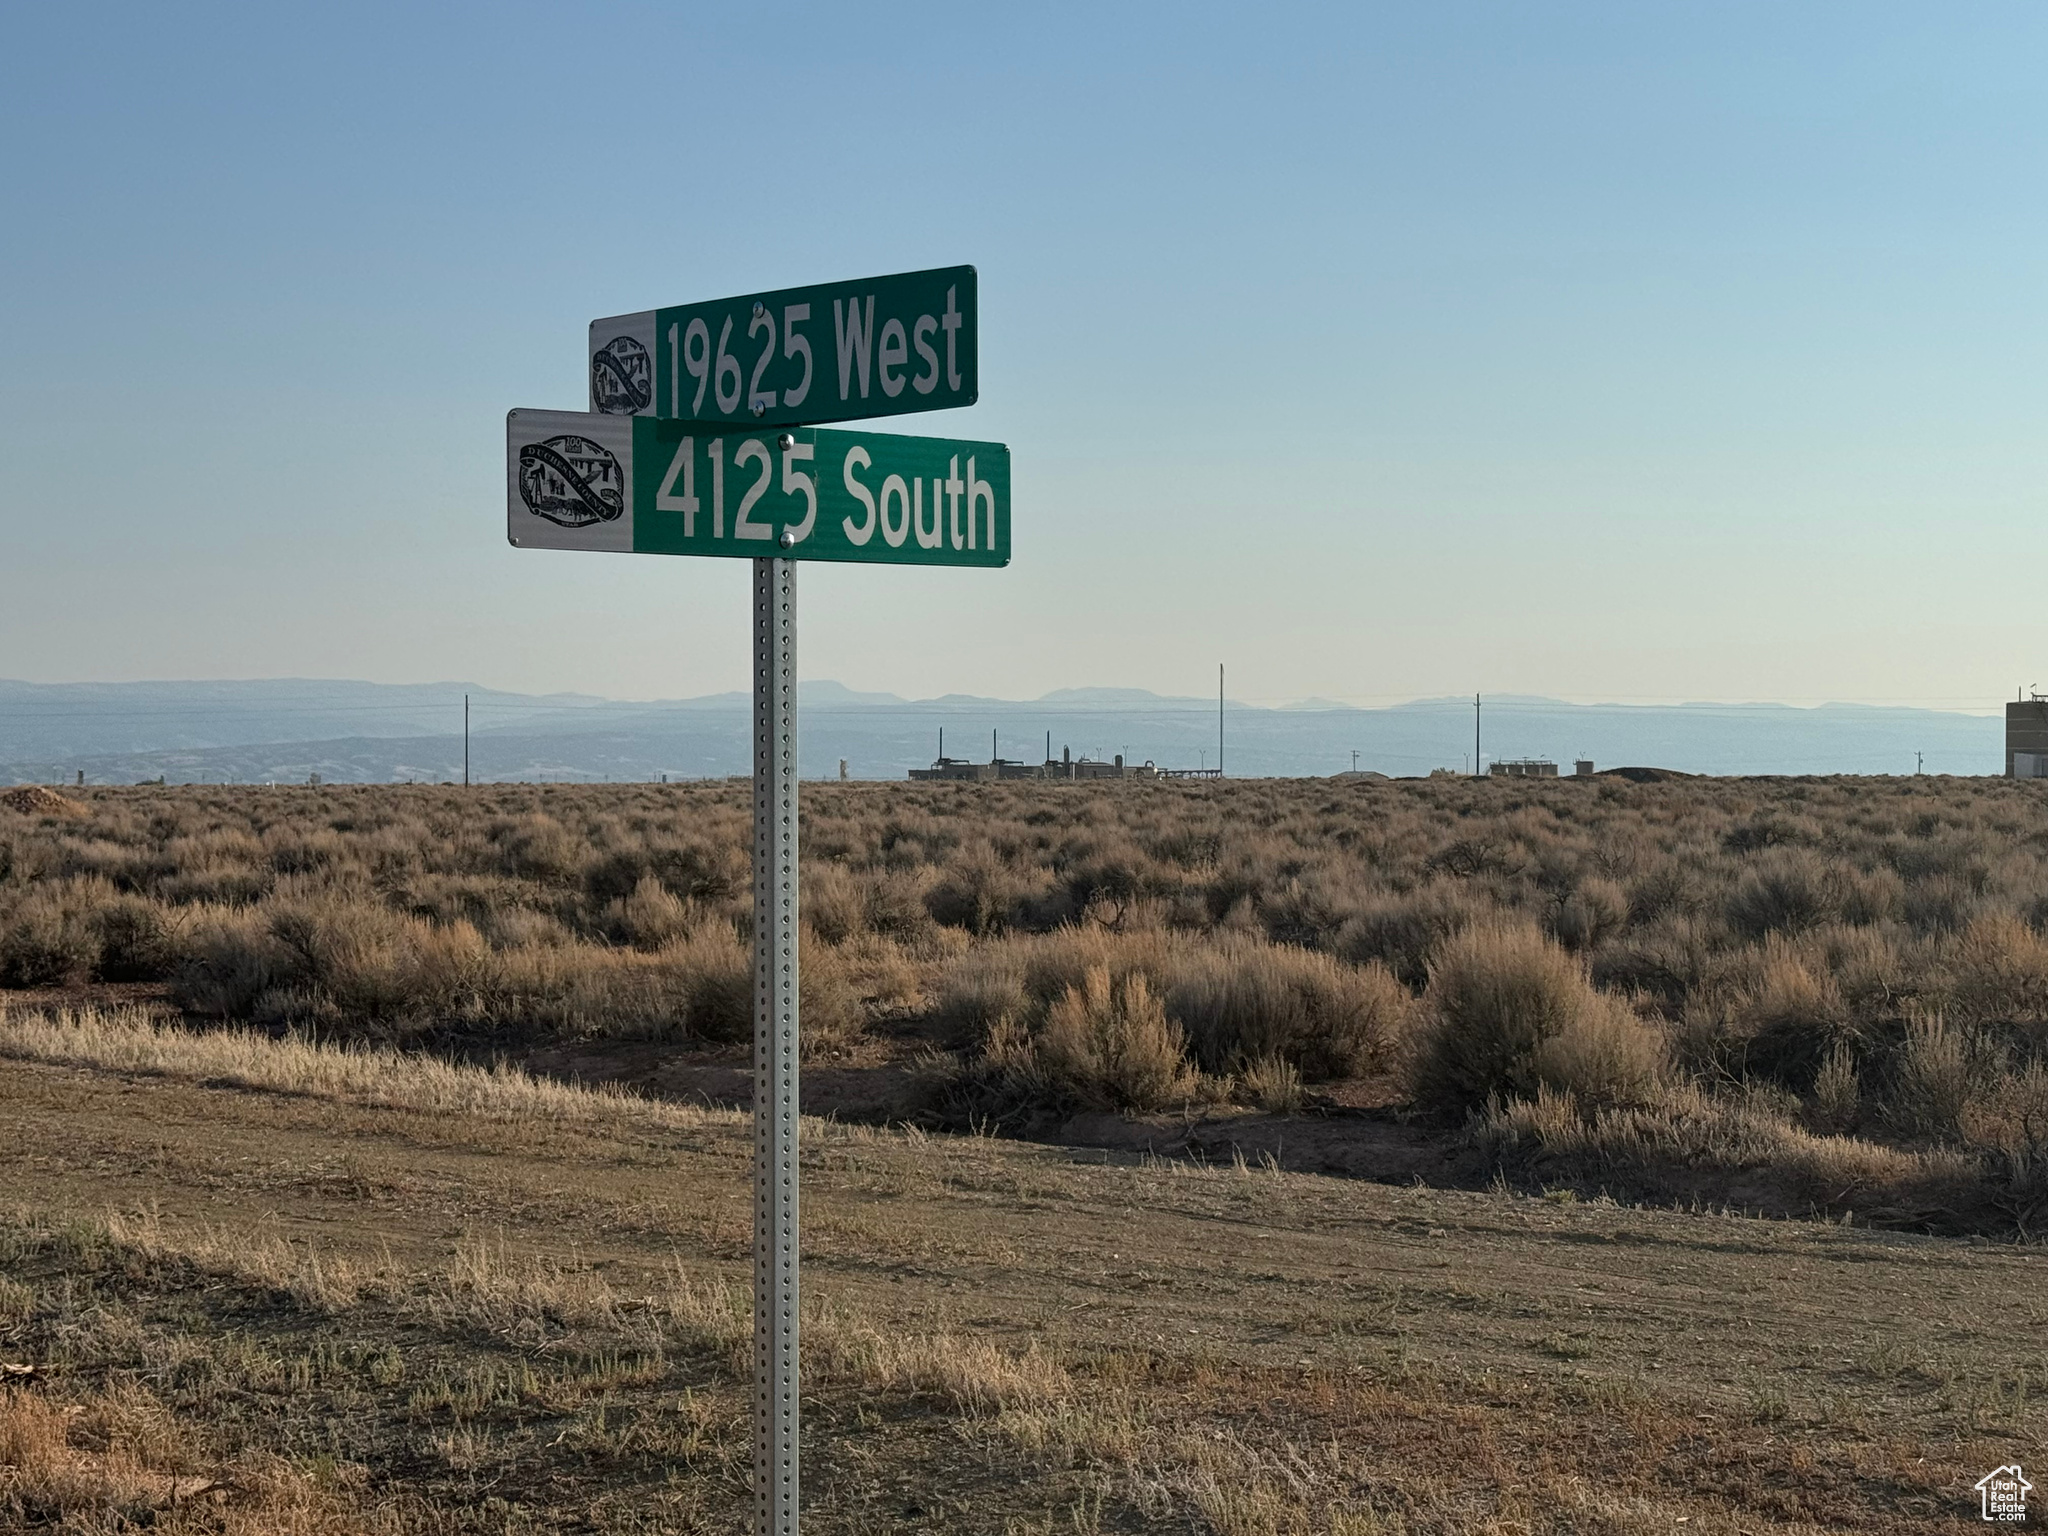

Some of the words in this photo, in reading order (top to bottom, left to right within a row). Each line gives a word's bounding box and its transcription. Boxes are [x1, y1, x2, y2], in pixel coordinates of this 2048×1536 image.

[667, 303, 813, 420] 19625
[833, 284, 962, 400] West
[528, 447, 580, 485] DUCHESNE
[577, 483, 608, 516] COUNTY
[566, 436, 582, 447] 100
[656, 437, 817, 547] 4125
[842, 445, 995, 551] South
